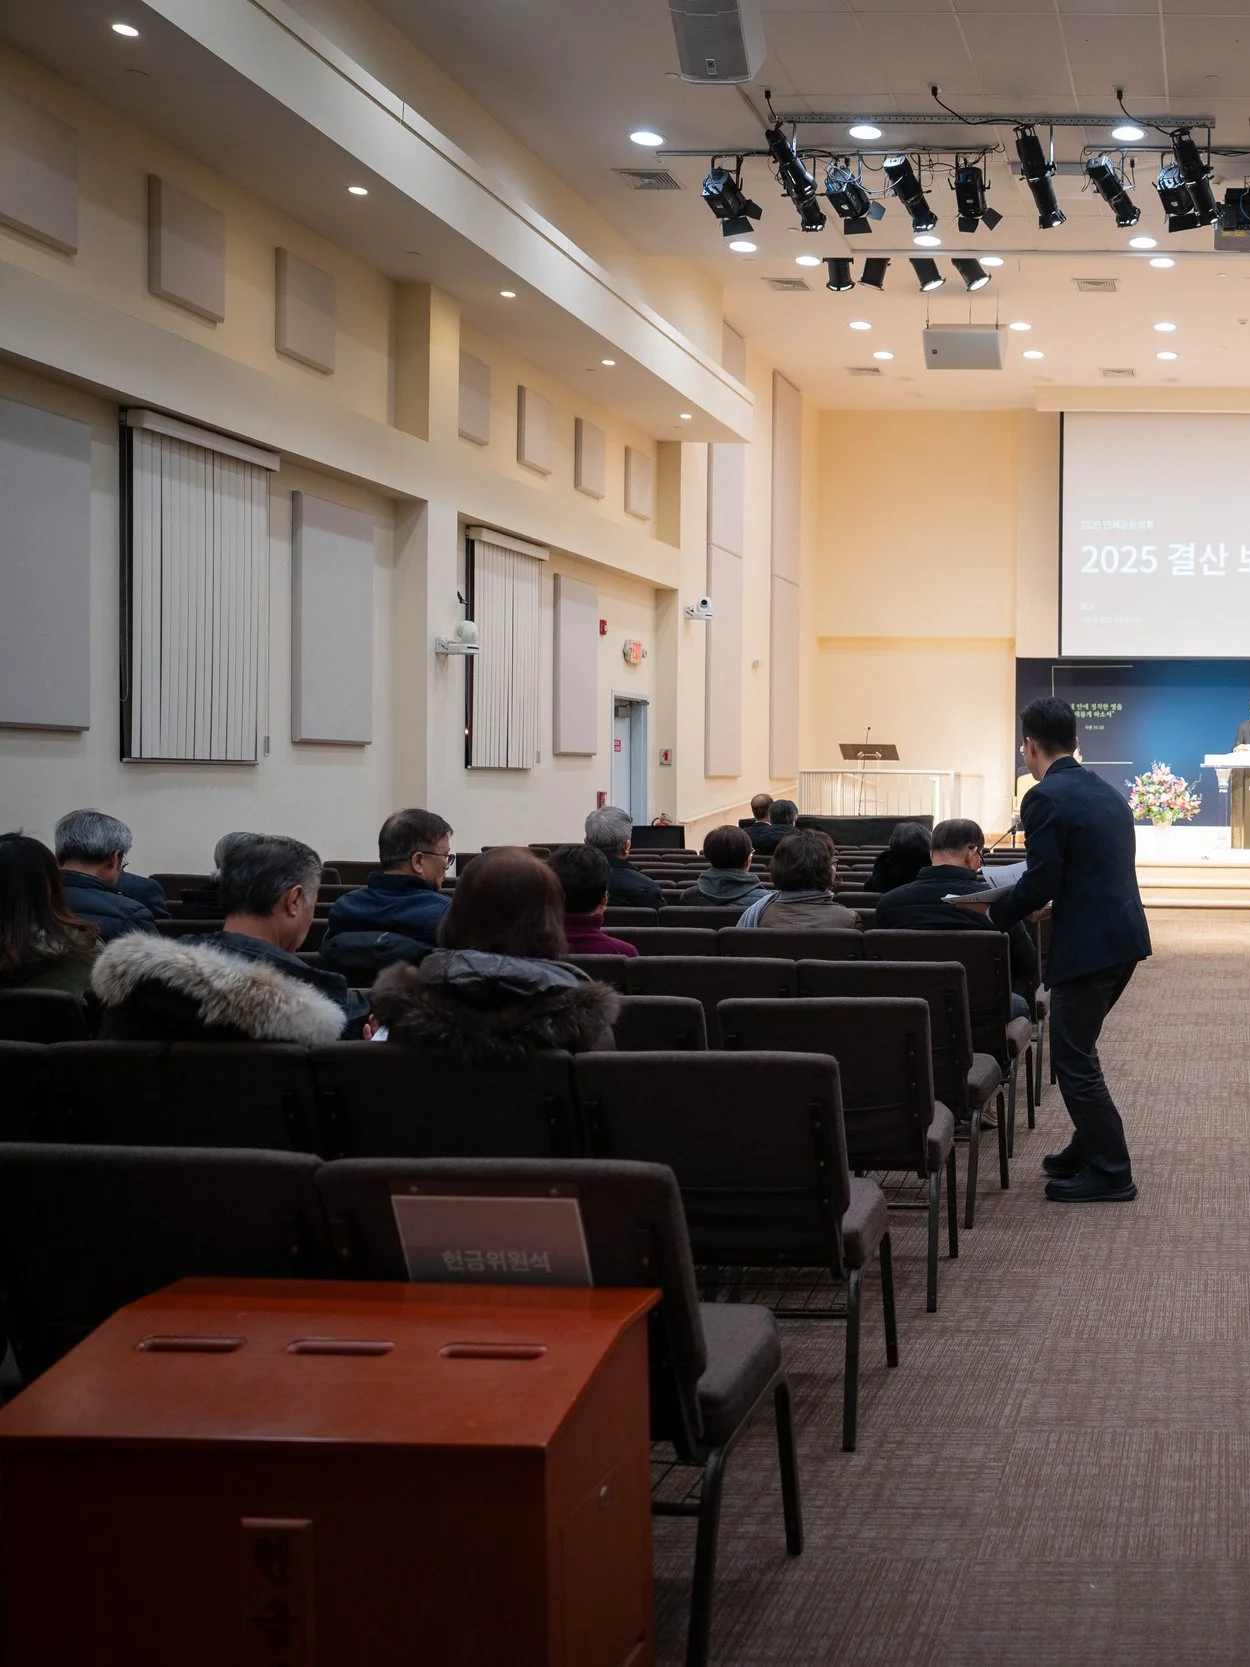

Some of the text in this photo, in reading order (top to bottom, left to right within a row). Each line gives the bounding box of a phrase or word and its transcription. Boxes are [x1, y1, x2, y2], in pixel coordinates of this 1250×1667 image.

[1081, 545, 1158, 574] 2025
[1168, 542, 1228, 576] 결산
[442, 1249, 551, 1273] 헌금위원석
